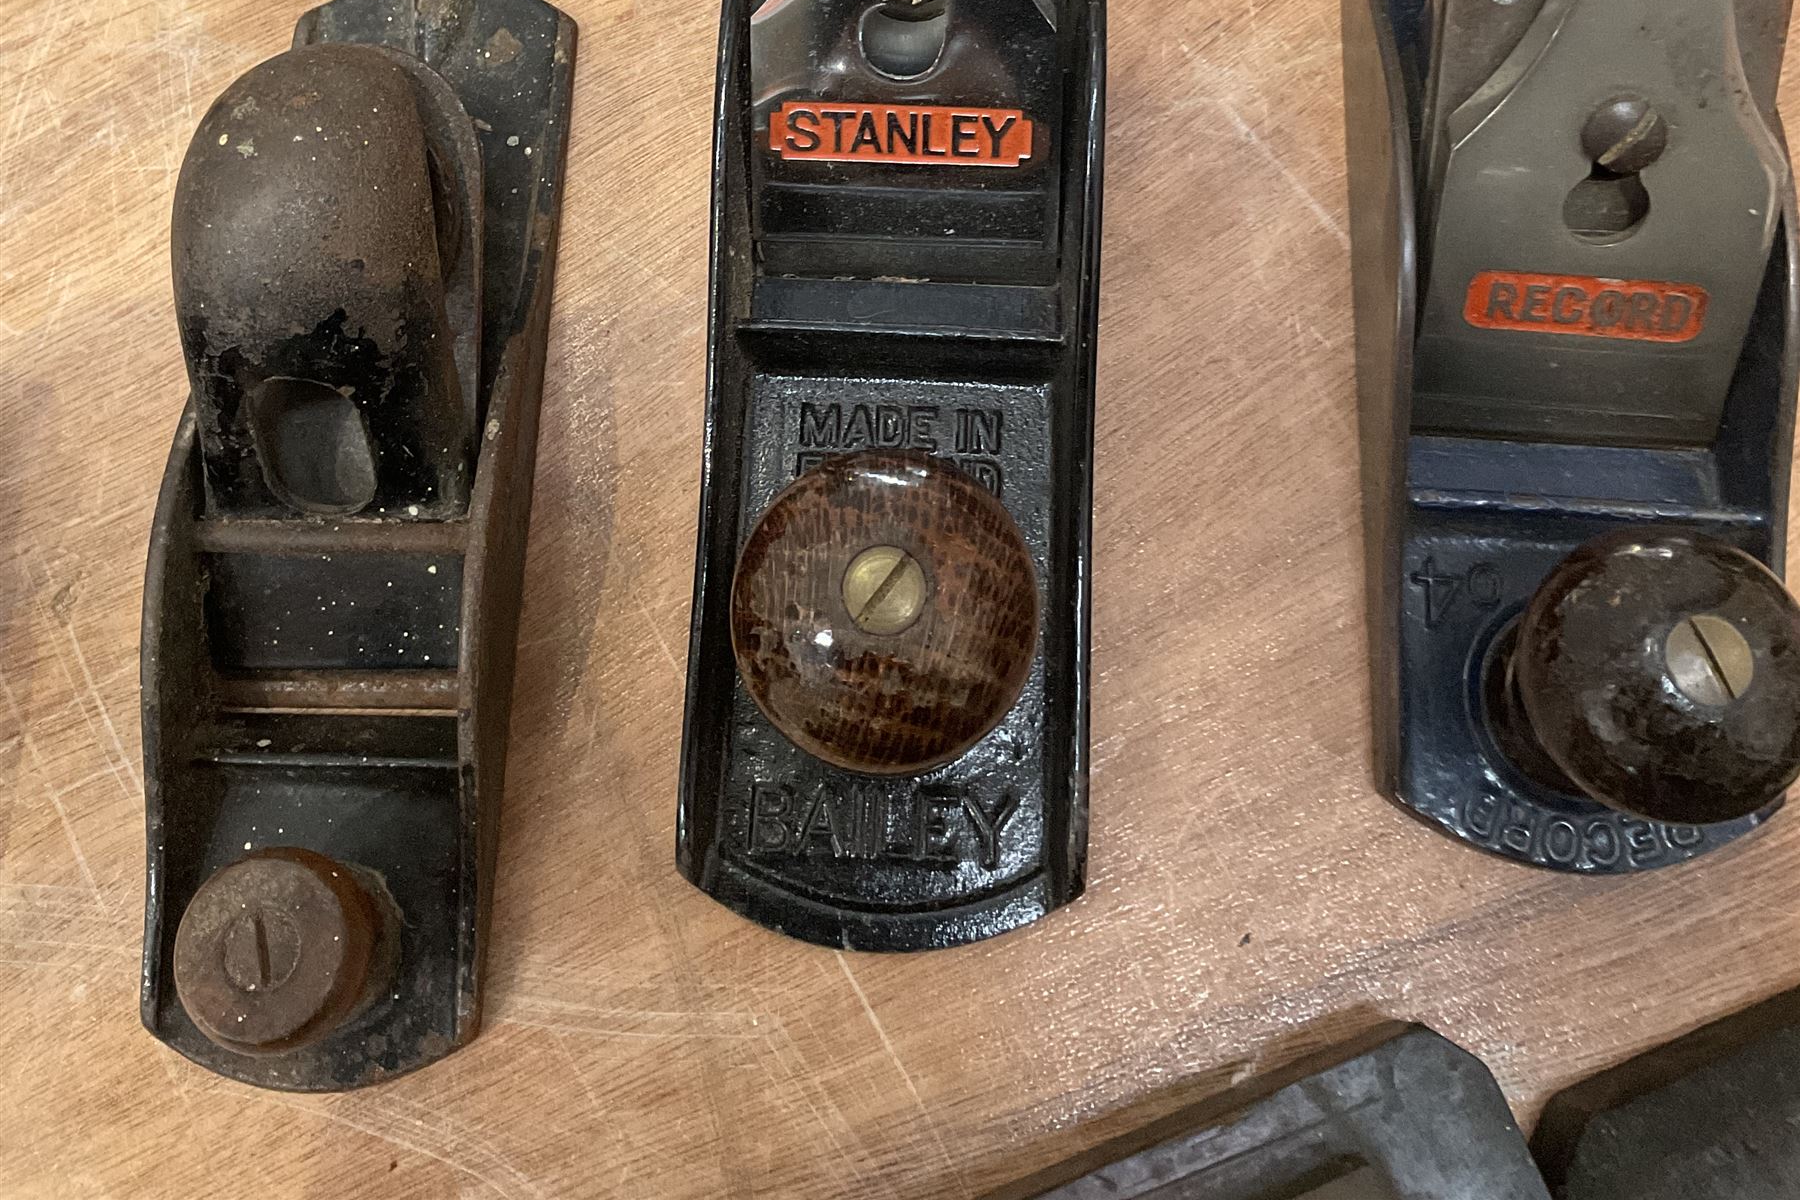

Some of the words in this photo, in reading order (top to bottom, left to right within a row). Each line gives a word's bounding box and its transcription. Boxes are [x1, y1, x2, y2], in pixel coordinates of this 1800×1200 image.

[785, 108, 1017, 158] STANLEY
[1486, 280, 1692, 334] RECORD
[799, 401, 940, 451] MADE
[954, 407, 1004, 455] IN
[748, 780, 1021, 870] BAILEY
